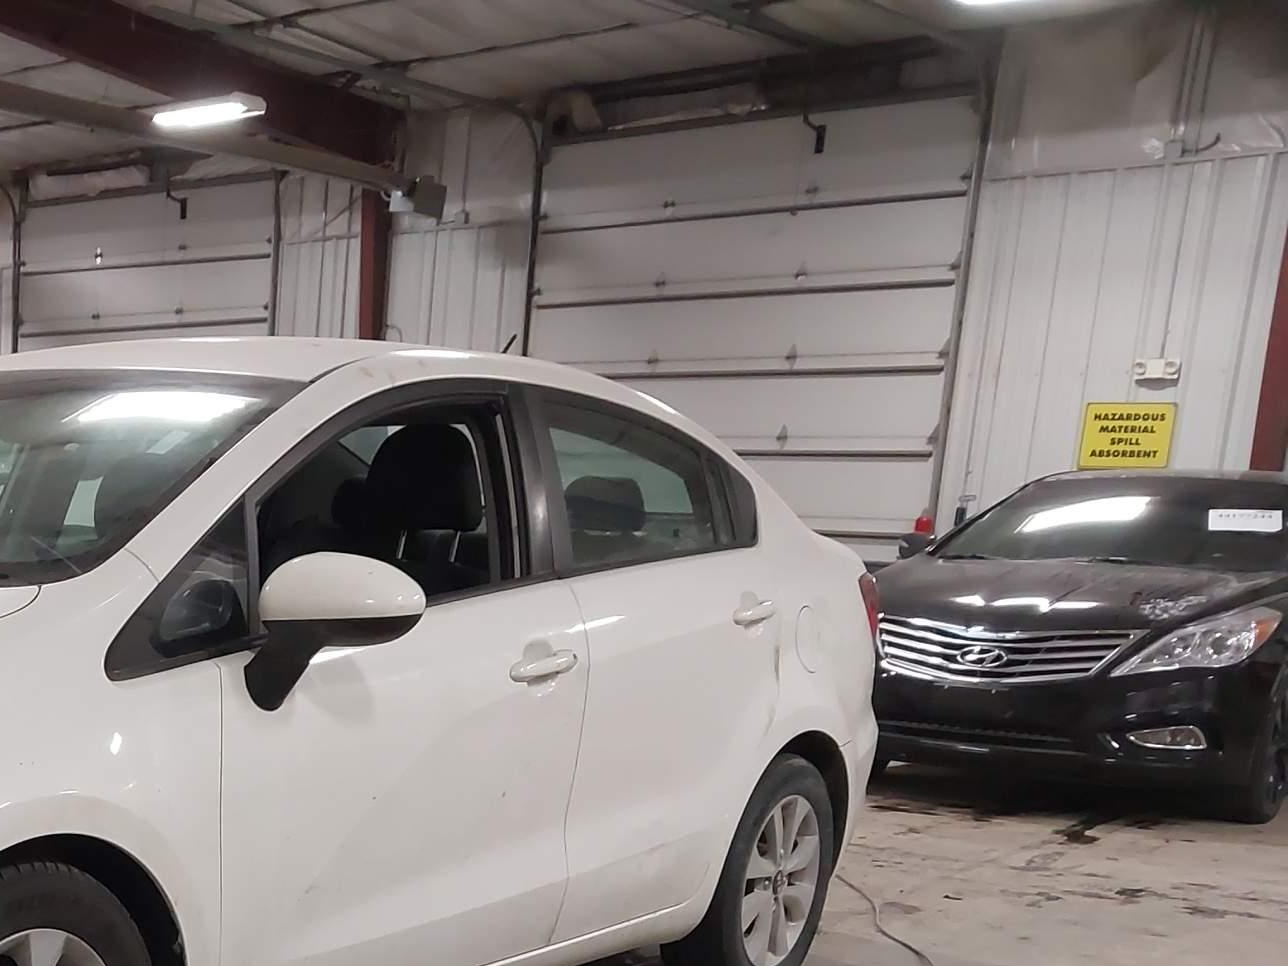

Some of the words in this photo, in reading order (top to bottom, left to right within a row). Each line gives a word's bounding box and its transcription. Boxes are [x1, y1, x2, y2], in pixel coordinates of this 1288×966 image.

[1094, 413, 1166, 421] HAZARDOUS
[1099, 425, 1156, 433] MATERIAL
[1109, 437, 1141, 446] SPILL
[1089, 449, 1159, 458] ABSORBENT
